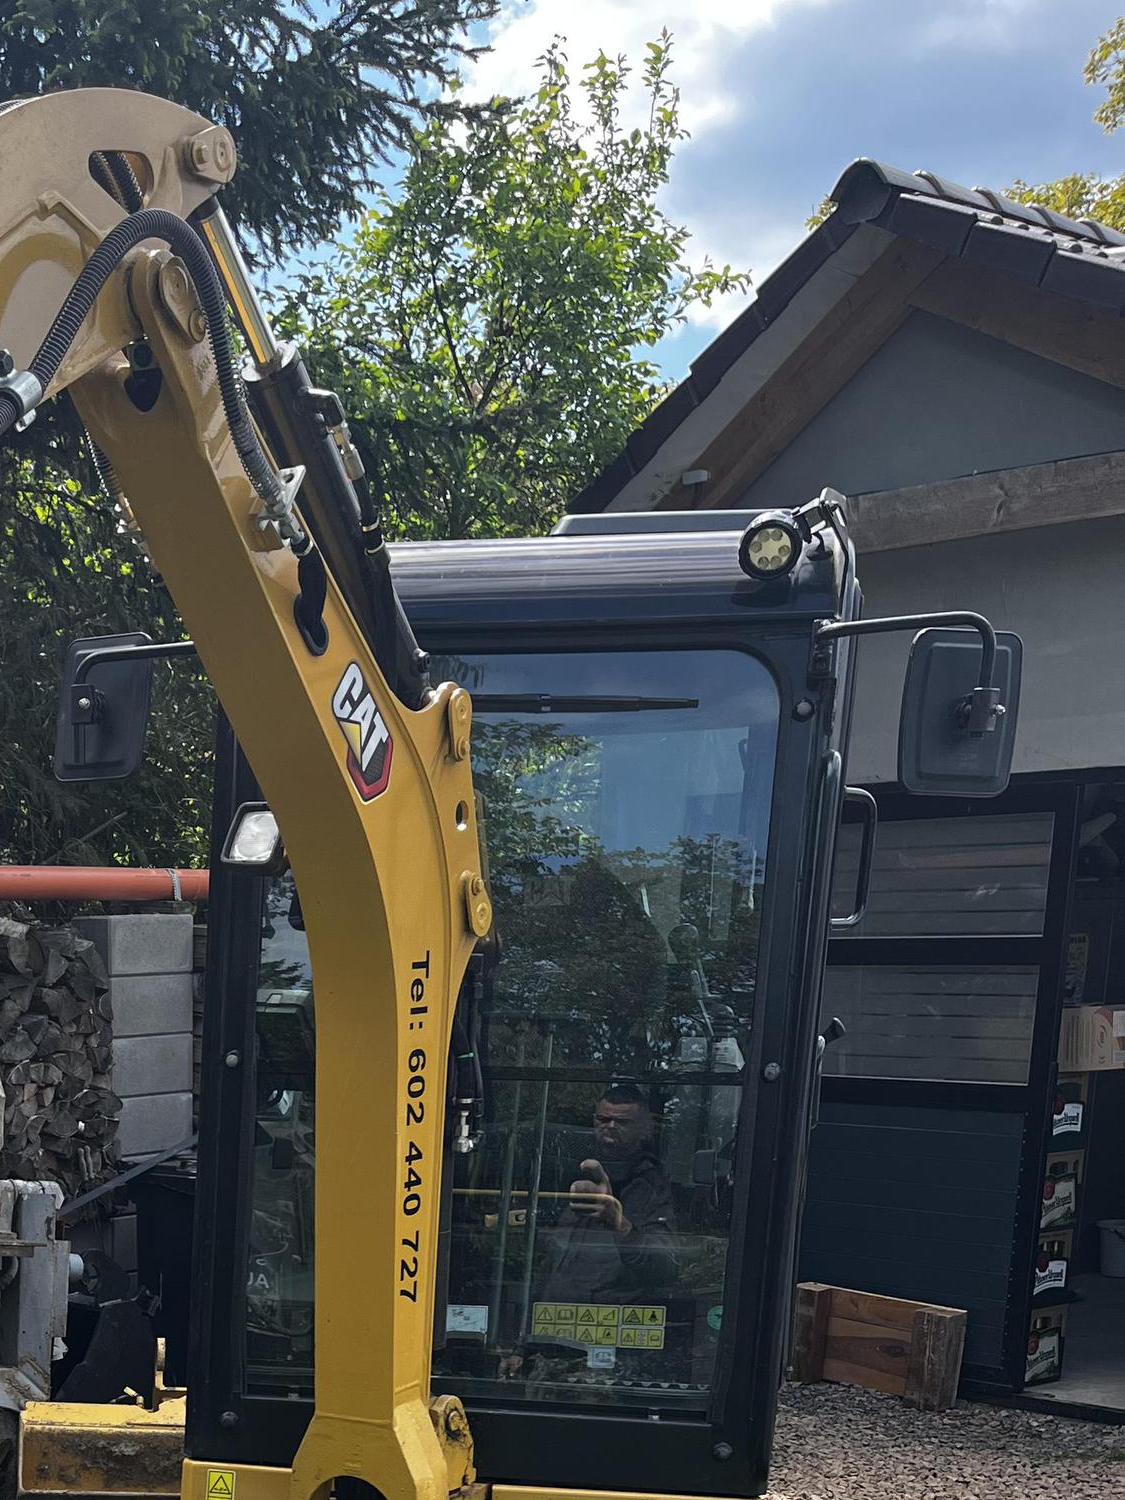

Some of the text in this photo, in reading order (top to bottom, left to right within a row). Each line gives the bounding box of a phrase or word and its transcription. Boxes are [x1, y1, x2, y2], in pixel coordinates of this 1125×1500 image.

[332, 662, 390, 773] CAT
[400, 950, 430, 1302] Tel: 602 440 727
